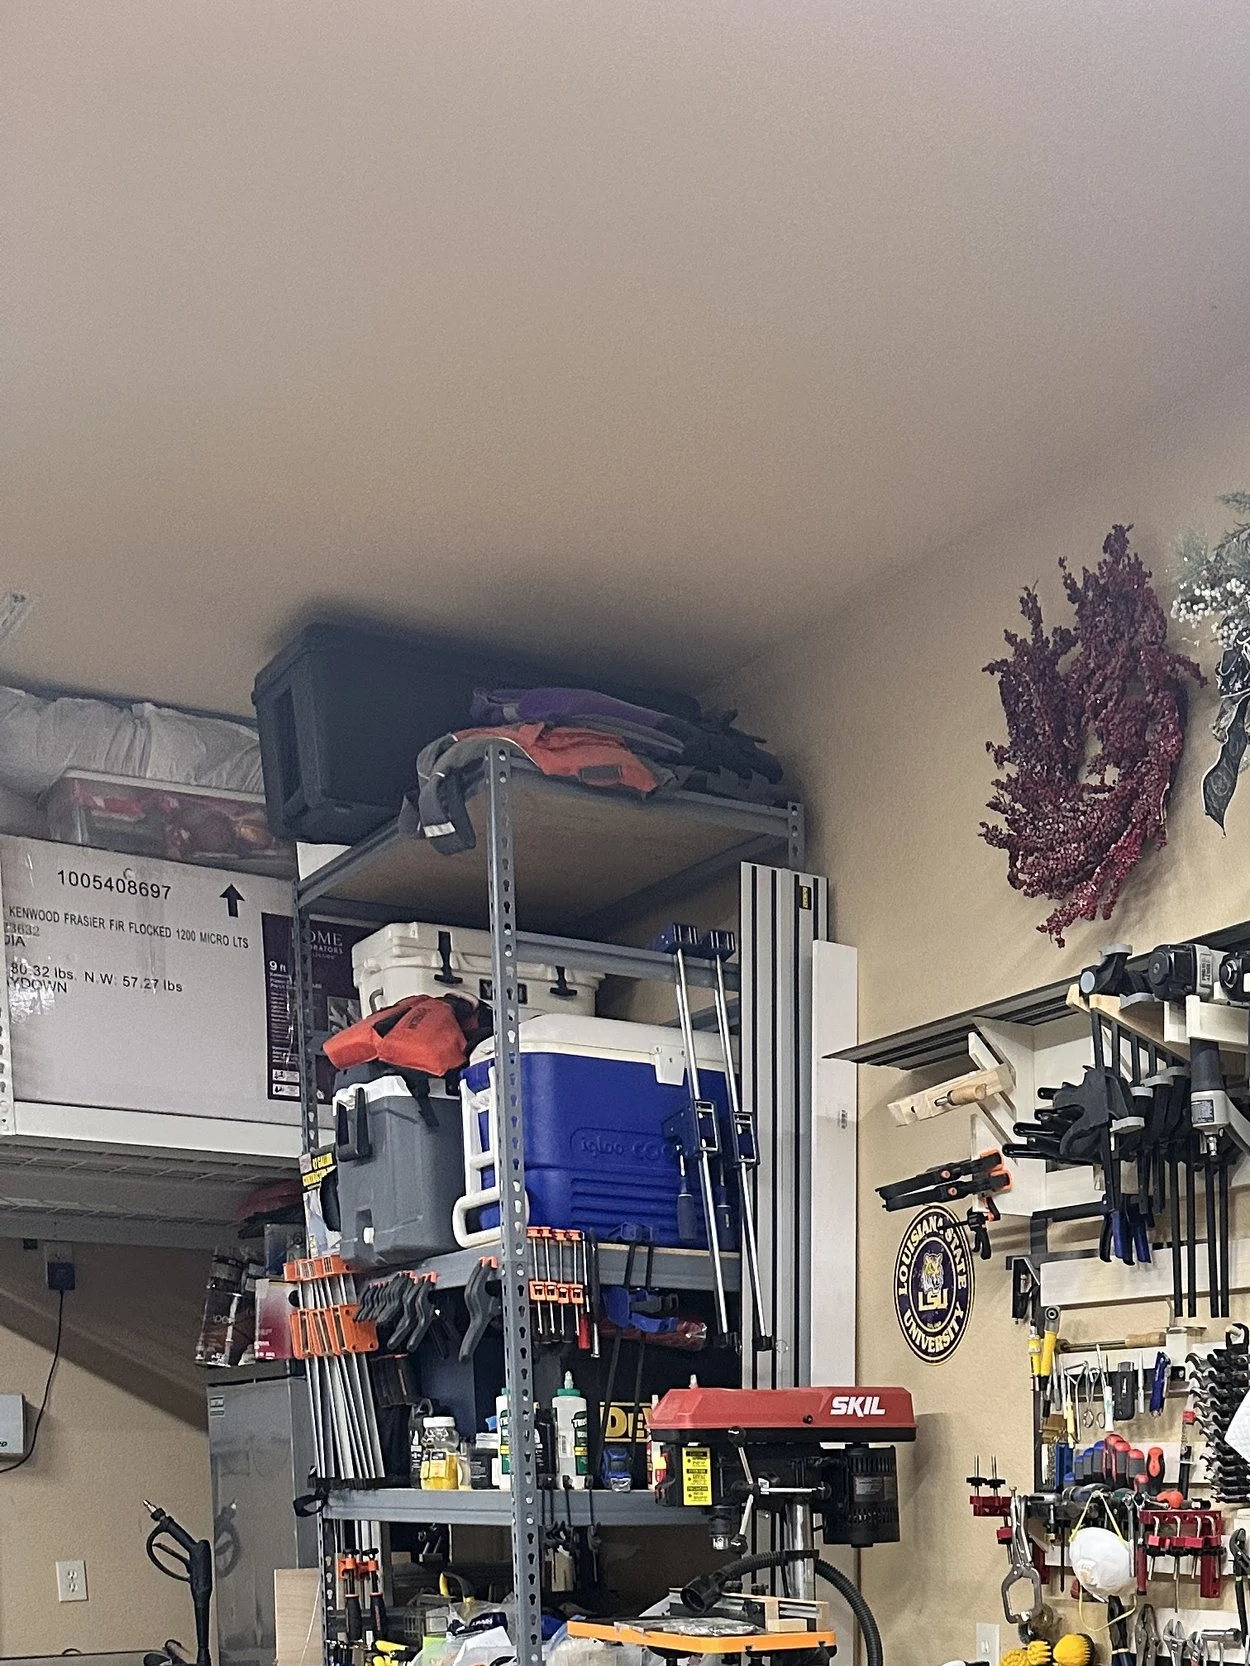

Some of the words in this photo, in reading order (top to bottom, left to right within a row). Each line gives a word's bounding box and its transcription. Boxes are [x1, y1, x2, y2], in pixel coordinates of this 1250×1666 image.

[57, 869, 171, 900] 1005408697
[9, 905, 60, 923] KENWOOD
[64, 911, 105, 929] FRASIER
[109, 917, 126, 931] FIR
[129, 922, 172, 938] FLOCKED
[176, 928, 196, 942] 1200
[200, 932, 229, 946] MICRO
[232, 936, 249, 949] LTS
[269, 961, 278, 971] 9
[164, 980, 183, 994] lbs
[899, 1216, 944, 1296] LOUISIANA
[945, 1228, 967, 1289] STATE
[918, 1288, 948, 1312] LSU
[903, 1302, 964, 1353] UNIVERSITY
[830, 1396, 886, 1417] SKIL
